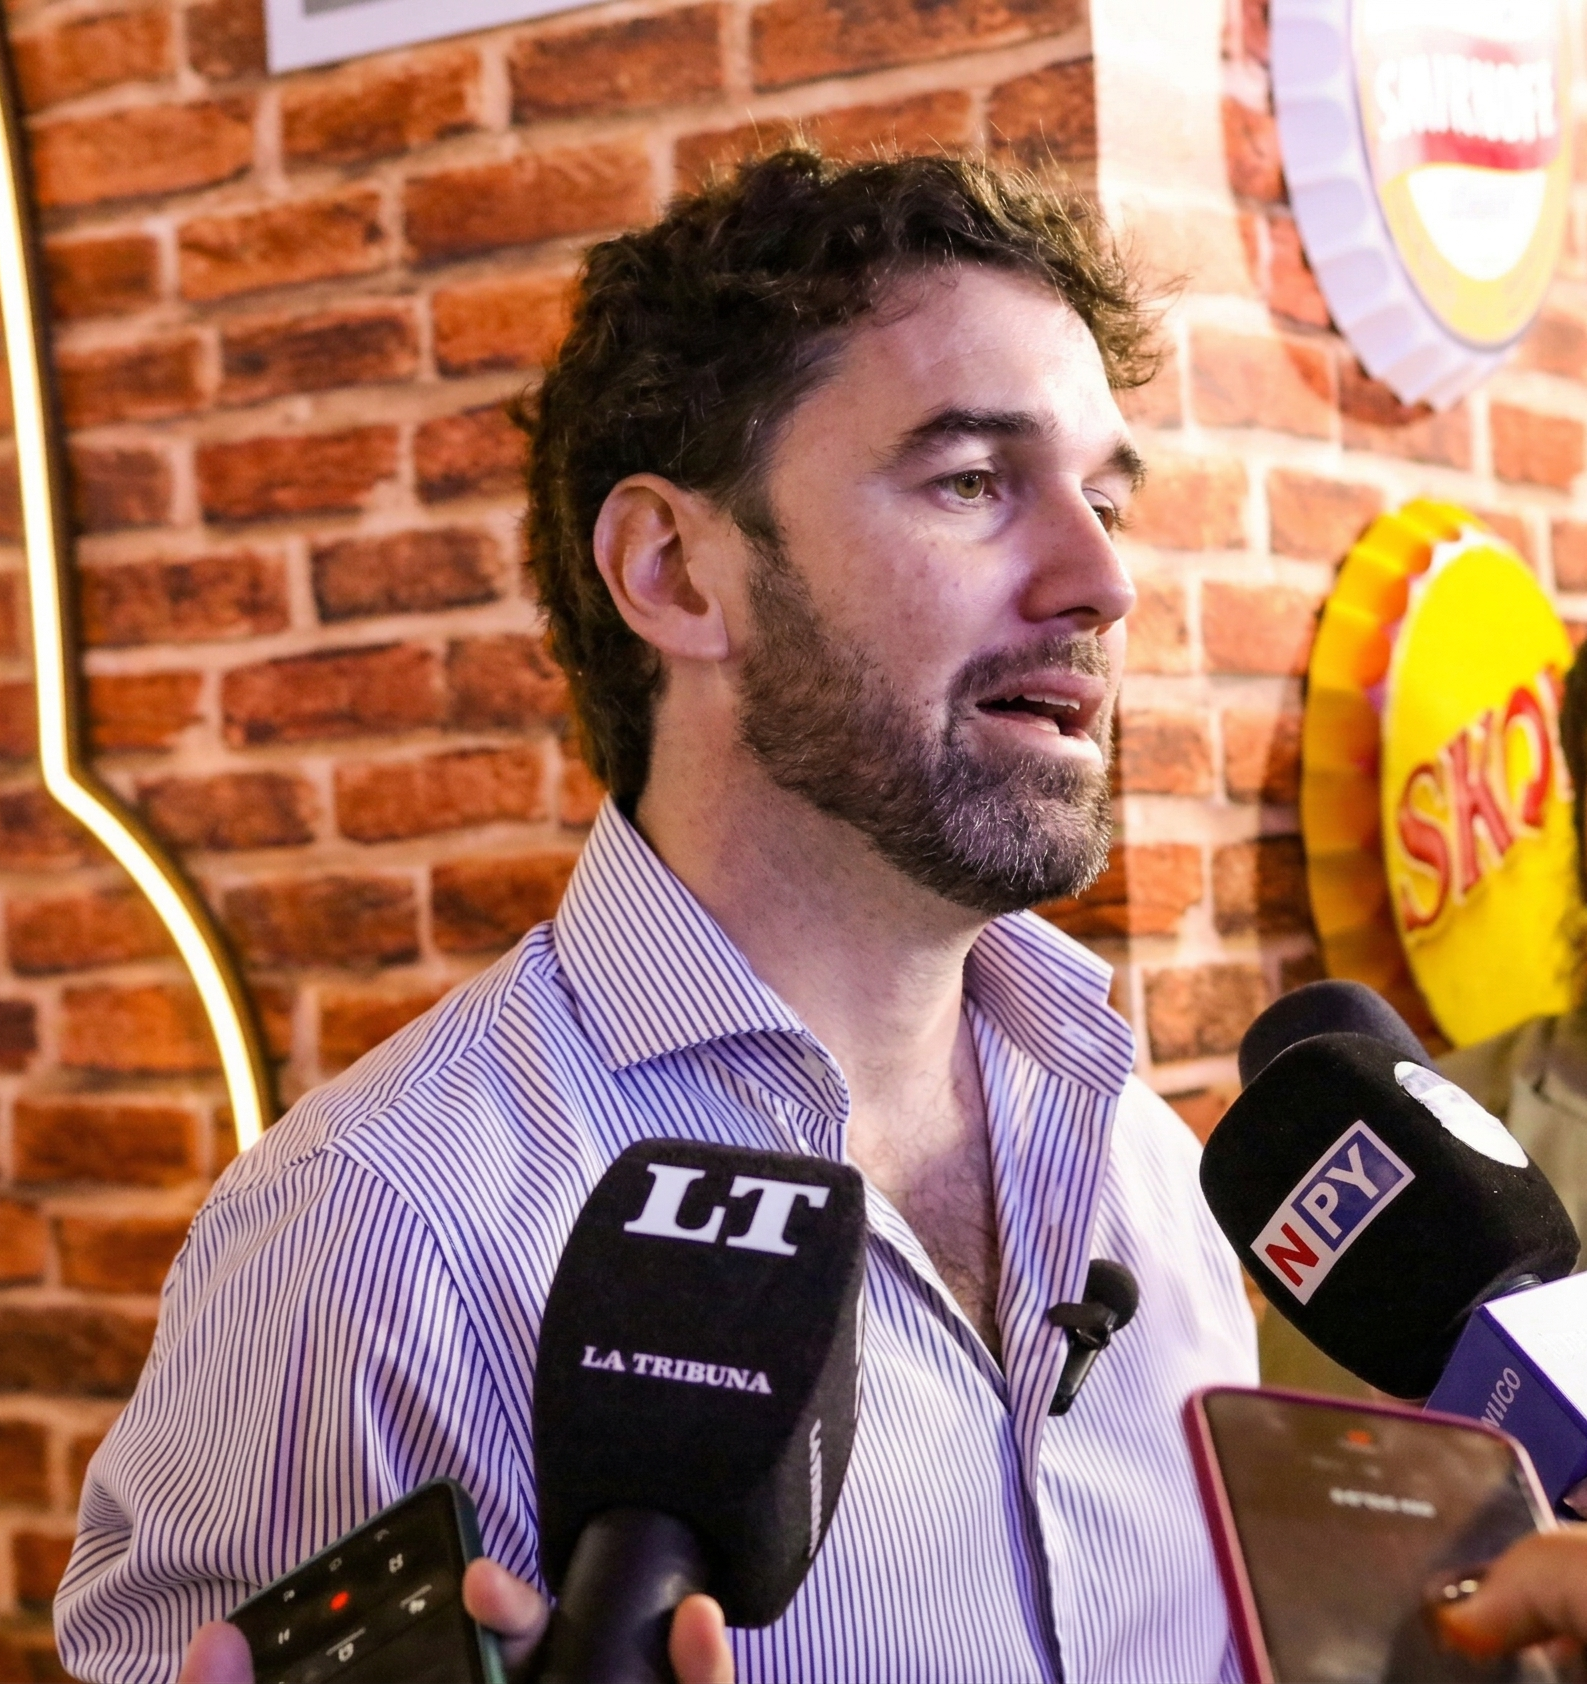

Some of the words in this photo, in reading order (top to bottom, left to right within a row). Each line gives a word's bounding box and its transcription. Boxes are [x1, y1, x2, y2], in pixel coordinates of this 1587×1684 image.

[624, 1163, 830, 1256] LT
[1265, 1143, 1379, 1287] NPY
[581, 1345, 626, 1372] LA
[632, 1353, 772, 1394] TRIBUNA
